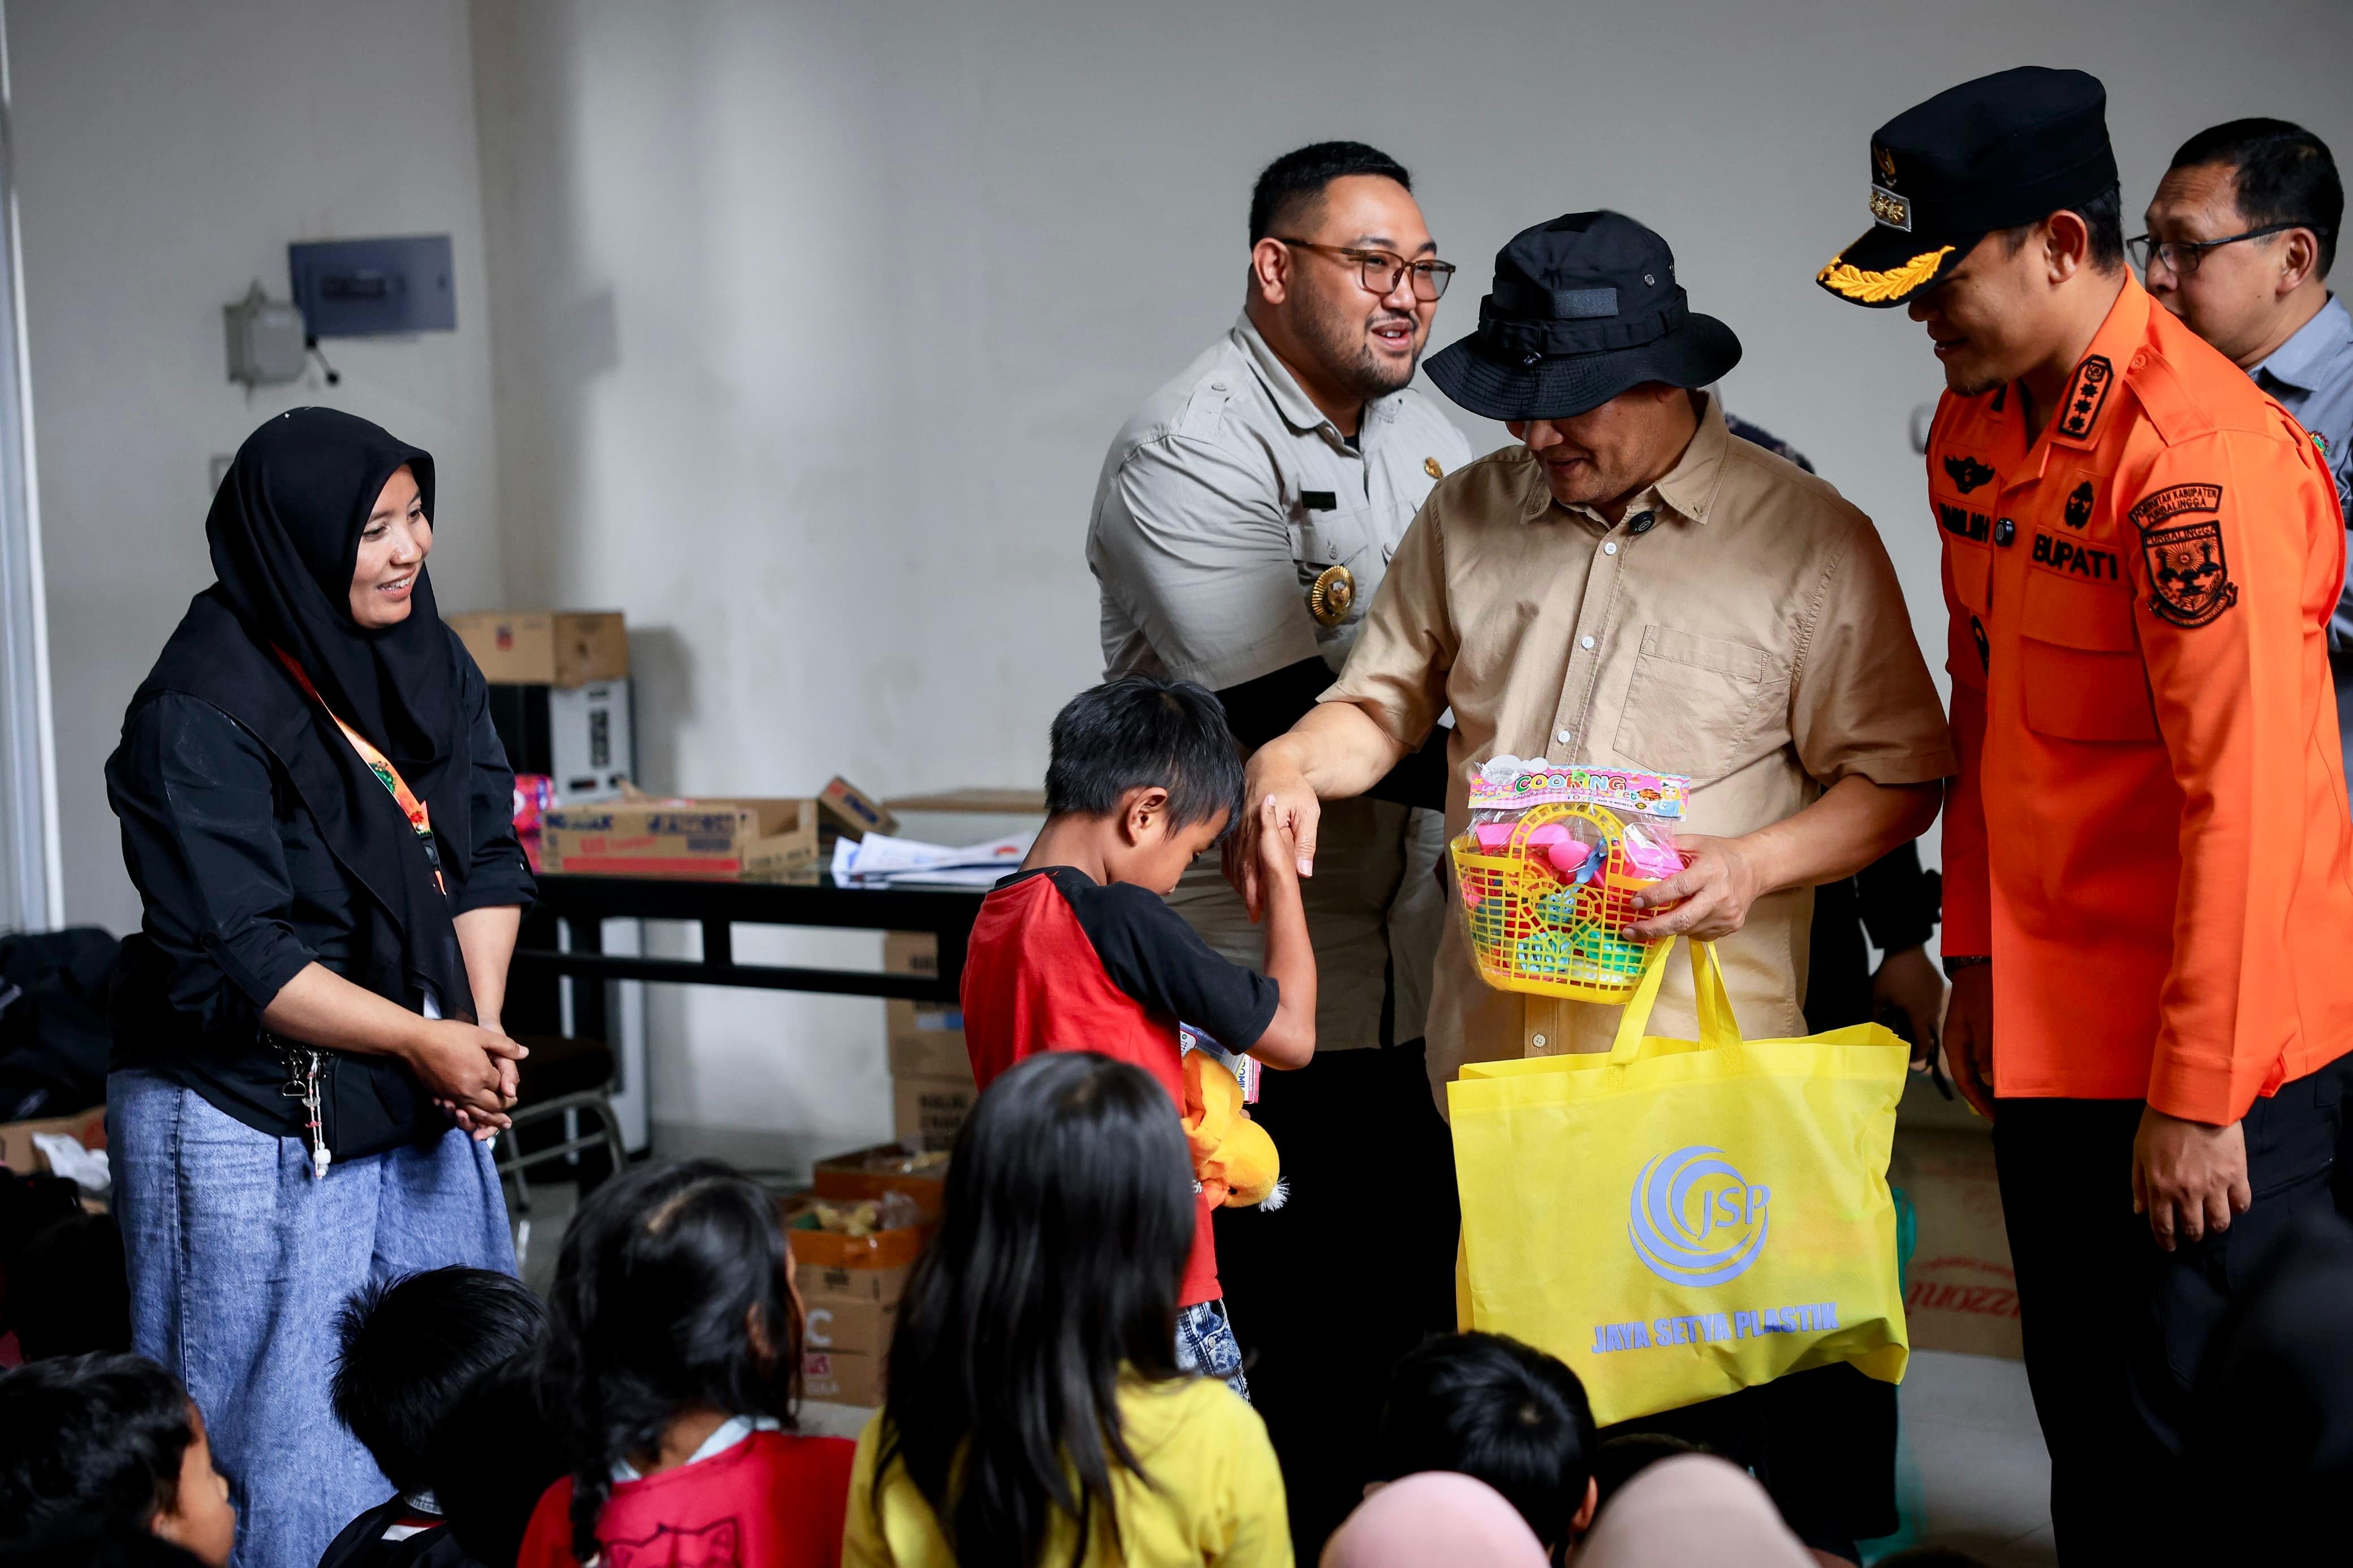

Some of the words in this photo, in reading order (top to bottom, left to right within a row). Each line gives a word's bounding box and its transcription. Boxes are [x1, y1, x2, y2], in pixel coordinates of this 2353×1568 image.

[2173, 487, 2217, 500] KABUPATEN
[2147, 525, 2217, 544] PURBALINGGA
[2032, 533, 2118, 580] BUPATI
[1515, 773, 1627, 792] COOKING
[1697, 1185, 1771, 1241] JSP
[1591, 1321, 1651, 1354] JAYA
[1653, 1312, 1731, 1346] SETYA
[1734, 1302, 1839, 1339] PLASTIK
